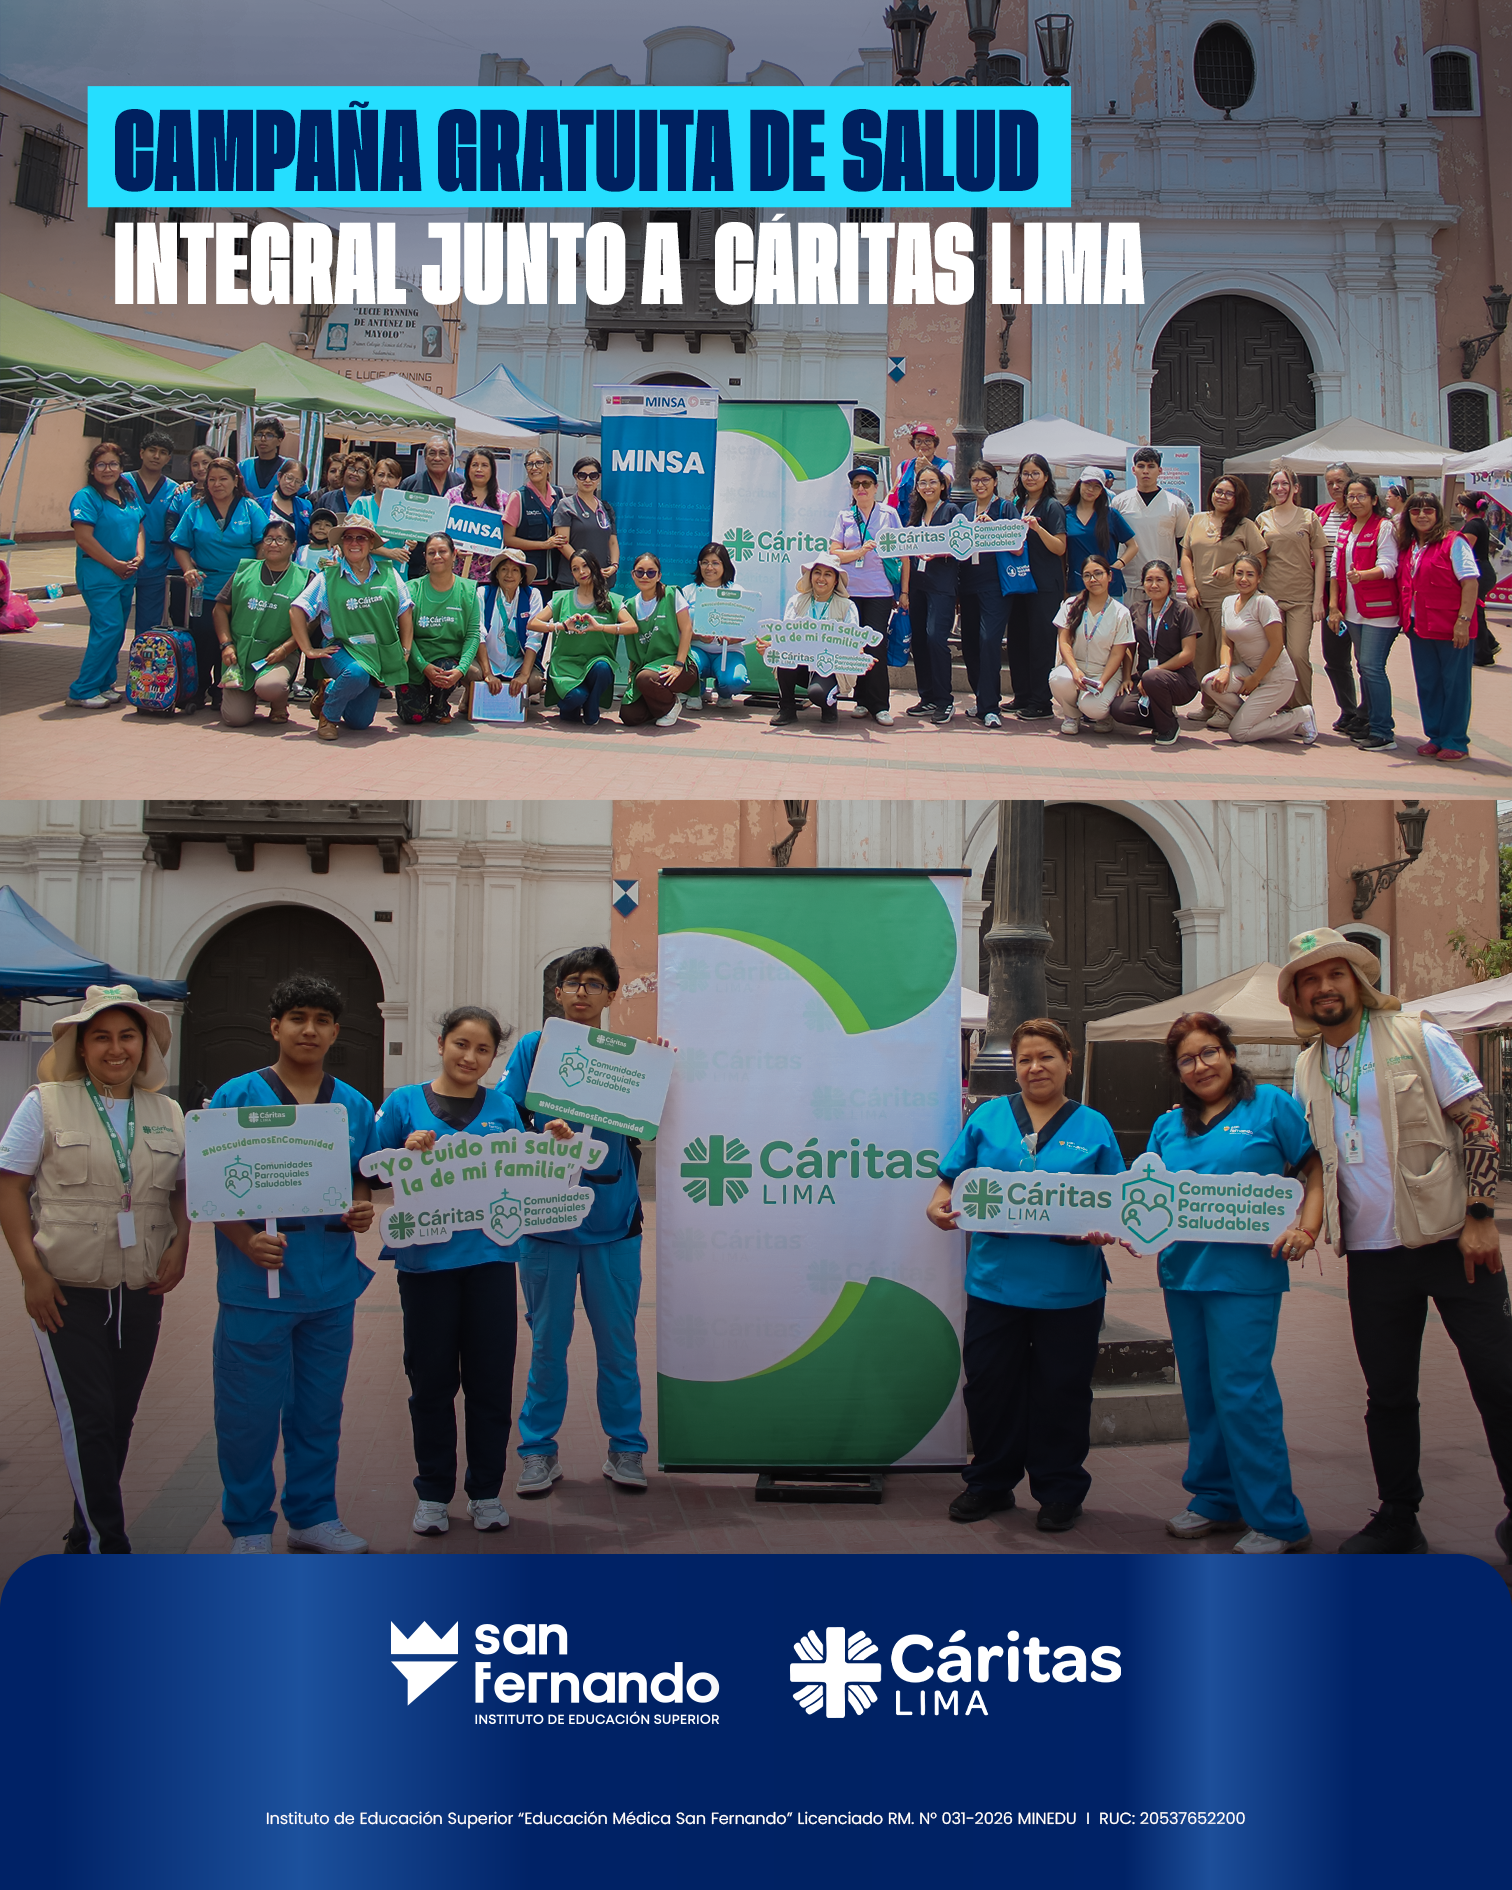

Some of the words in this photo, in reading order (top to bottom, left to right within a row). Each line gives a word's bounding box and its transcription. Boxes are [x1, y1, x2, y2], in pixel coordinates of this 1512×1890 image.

[383, 308, 419, 317] RYNNING
[354, 318, 365, 327] DE
[405, 319, 416, 328] DE
[645, 396, 686, 408] MINSA
[611, 449, 705, 475] MINSA
[447, 517, 502, 540] MINSA
[974, 524, 1025, 533] Comunidades
[897, 530, 946, 544] Cáritas
[974, 532, 1022, 541] Parroquiales
[974, 539, 1016, 548] Saludables
[899, 543, 919, 551] LIMA
[758, 552, 791, 563] LIMA
[775, 634, 786, 643] la
[789, 632, 802, 641] de
[805, 633, 818, 642] mi
[785, 621, 817, 631] cuido
[821, 622, 835, 632] mi
[838, 625, 870, 640] salud
[871, 635, 879, 644] y
[781, 651, 815, 662] Cáritas
[834, 653, 871, 663] Comunidades
[834, 659, 868, 668] Parroquiales
[605, 1036, 627, 1048] Cáritas
[712, 1048, 802, 1070] Cáritas
[590, 1058, 646, 1080] Comunidades
[588, 1067, 640, 1087] Parroquiales
[586, 1076, 631, 1094] Saludables
[849, 1085, 940, 1107] Cáritas
[259, 1111, 286, 1119] Cáritas
[202, 1136, 334, 1157] #NoscuidamosEnComunidad
[420, 1139, 483, 1165] cuido
[491, 1136, 517, 1154] mi
[524, 1138, 582, 1159] salud
[587, 1148, 601, 1164] y
[760, 1137, 939, 1179] Cáritas
[254, 1161, 313, 1171] Comunidades
[254, 1170, 310, 1180] Parroquiales
[401, 1178, 423, 1196] la
[430, 1168, 455, 1188] de
[462, 1161, 487, 1181] mi
[254, 1179, 303, 1188] Saludables
[1178, 1181, 1293, 1199] Comunidades
[524, 1192, 590, 1206] Comunidades
[763, 1184, 836, 1204] LIMA
[1008, 1182, 1112, 1208] Cáritas
[524, 1202, 585, 1217] Parroquiales
[1008, 1208, 1050, 1221] LIMA
[1178, 1198, 1285, 1217] Parroquiales
[418, 1207, 484, 1227] Cáritas
[524, 1214, 577, 1227] Saludables
[1178, 1215, 1270, 1231] Saludables
[419, 1227, 447, 1238] LIMA
[711, 1228, 802, 1250] Cáritas
[711, 1316, 802, 1338] Cáritas
